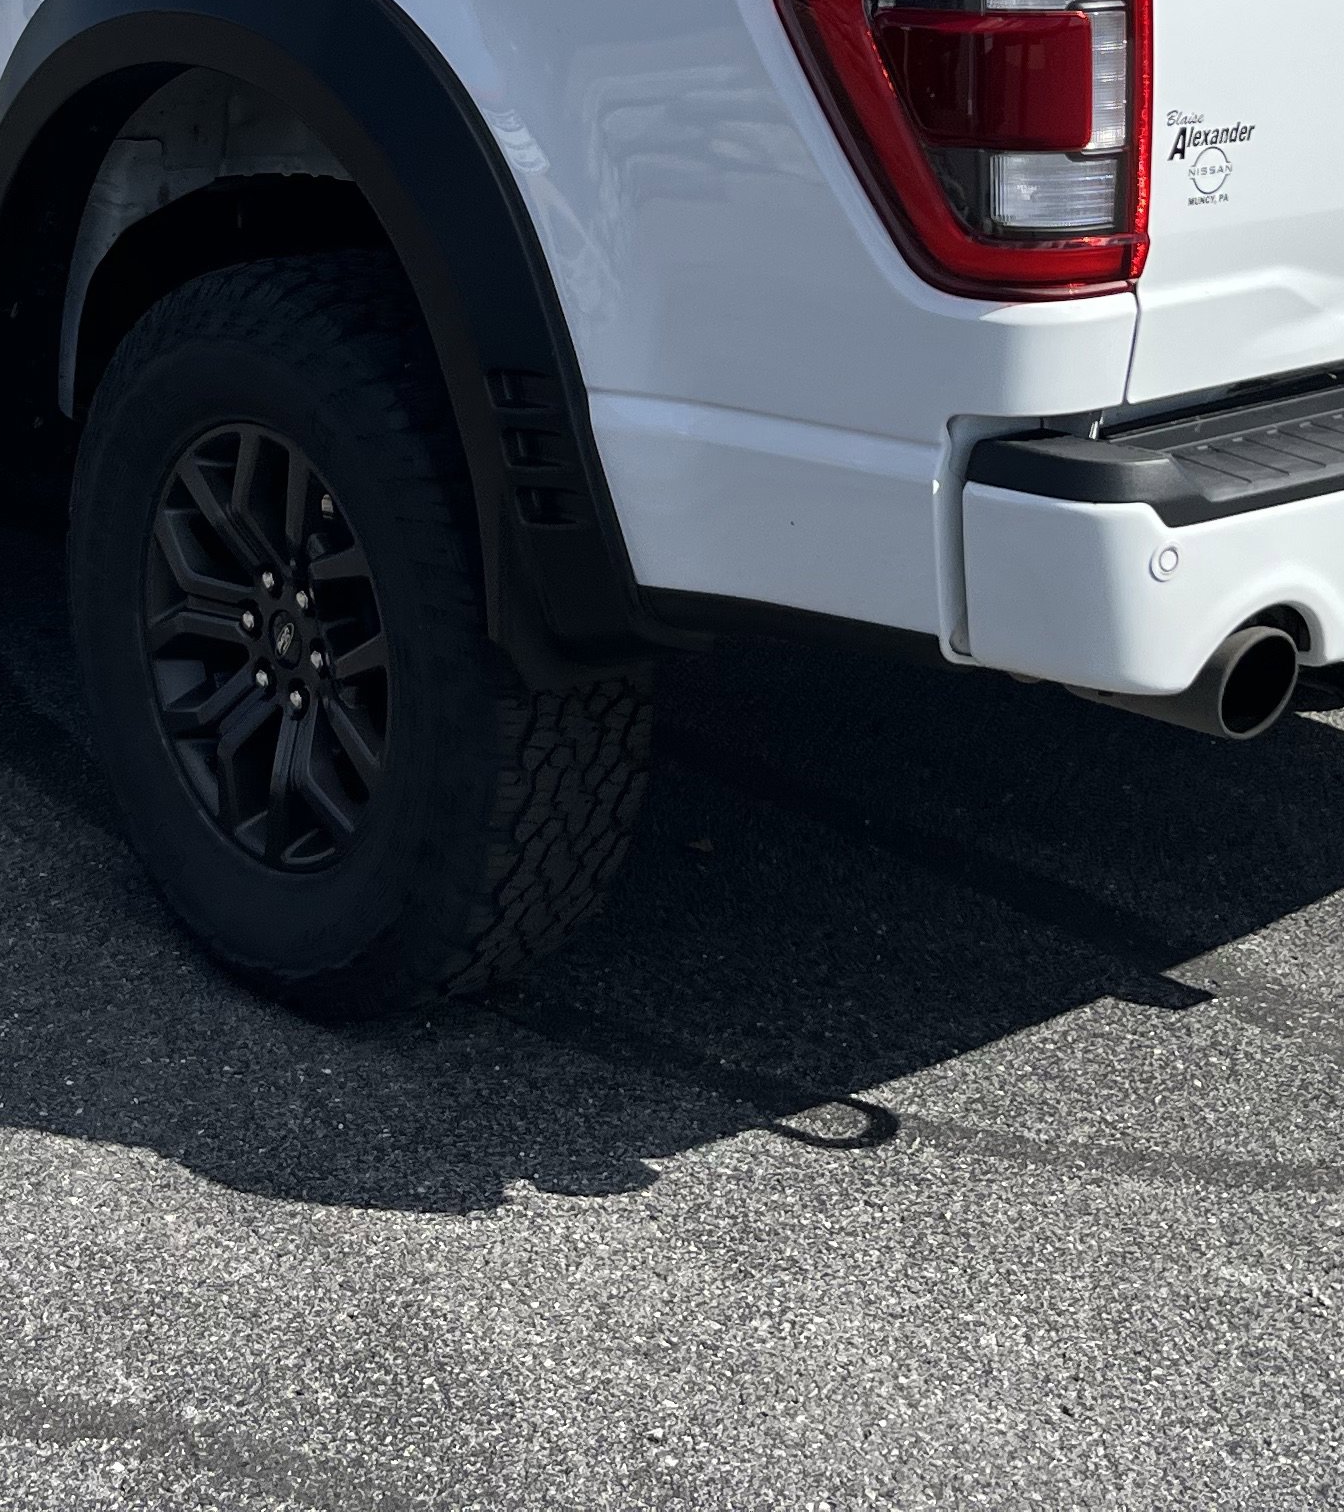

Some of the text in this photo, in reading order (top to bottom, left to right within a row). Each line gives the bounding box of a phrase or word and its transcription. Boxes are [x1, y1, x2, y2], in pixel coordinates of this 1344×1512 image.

[1166, 109, 1205, 127] Blaise
[1167, 121, 1256, 161] Alexander
[1187, 164, 1233, 177] NISSAN
[1218, 194, 1229, 203] PA
